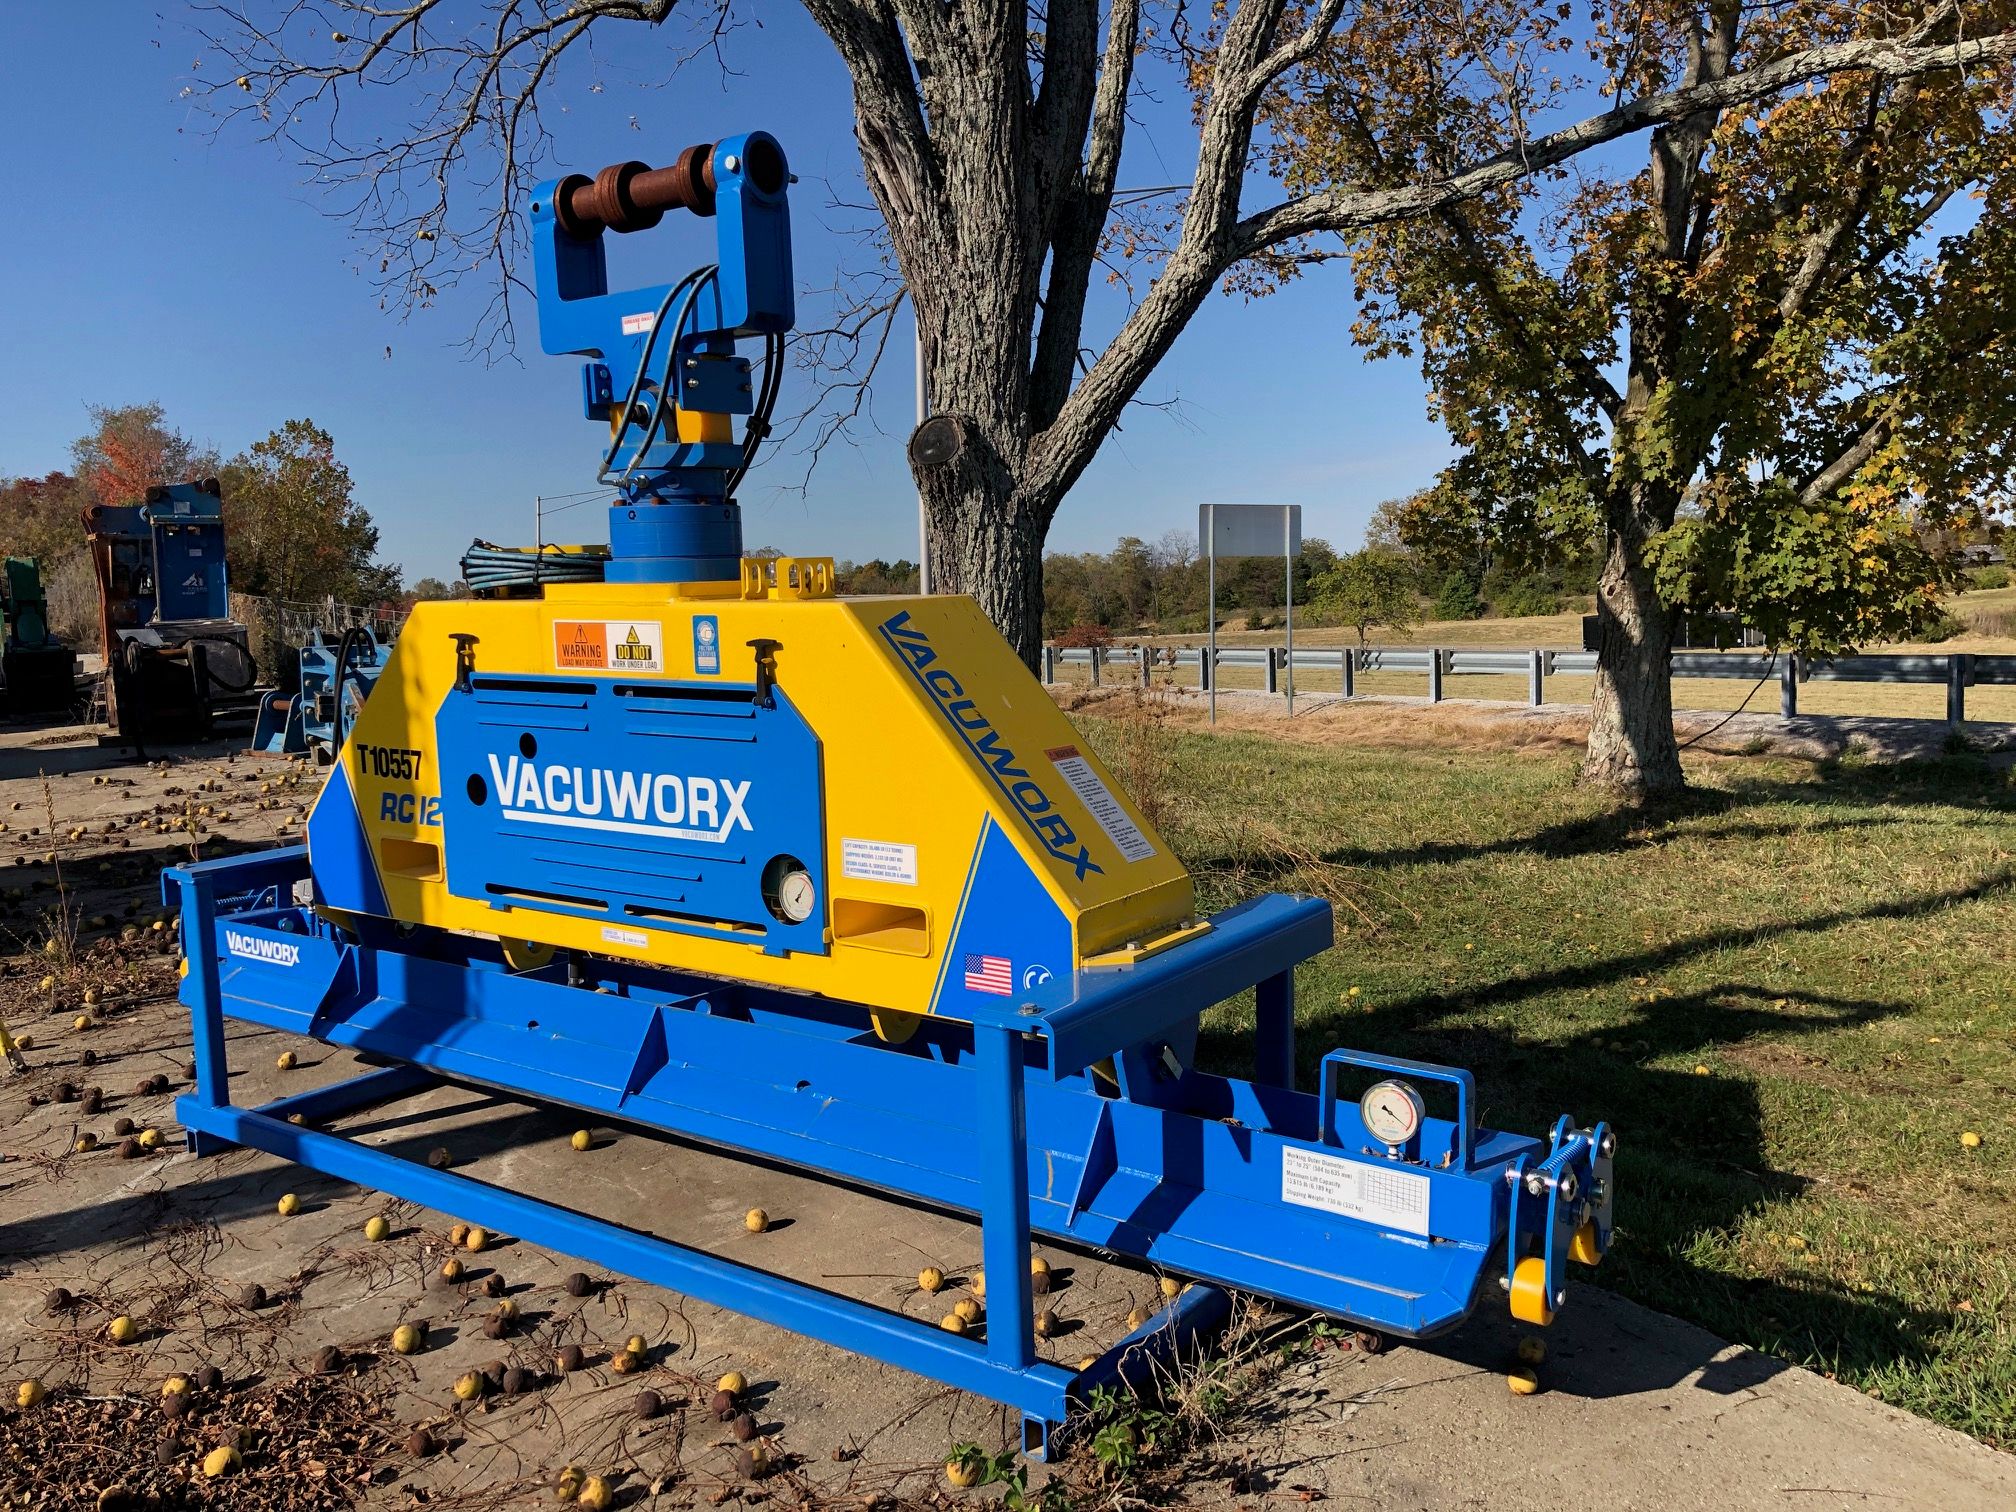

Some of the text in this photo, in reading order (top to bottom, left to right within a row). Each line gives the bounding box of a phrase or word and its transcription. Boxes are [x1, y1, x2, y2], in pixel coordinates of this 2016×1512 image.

[562, 644, 601, 658] WARNING
[617, 645, 651, 660] DO NOT
[586, 659, 603, 668] ROTATE
[611, 660, 658, 670] WORK UNDER LOAD
[883, 610, 1105, 882] VACUWORX
[356, 744, 421, 780] T10557
[488, 753, 753, 843] VACUWORX
[226, 930, 300, 967] VACUWORX
[1286, 1152, 1306, 1162] Working
[1308, 1155, 1321, 1165] Outer
[1286, 1170, 1309, 1180] Maximum
[1310, 1173, 1318, 1182] Lift
